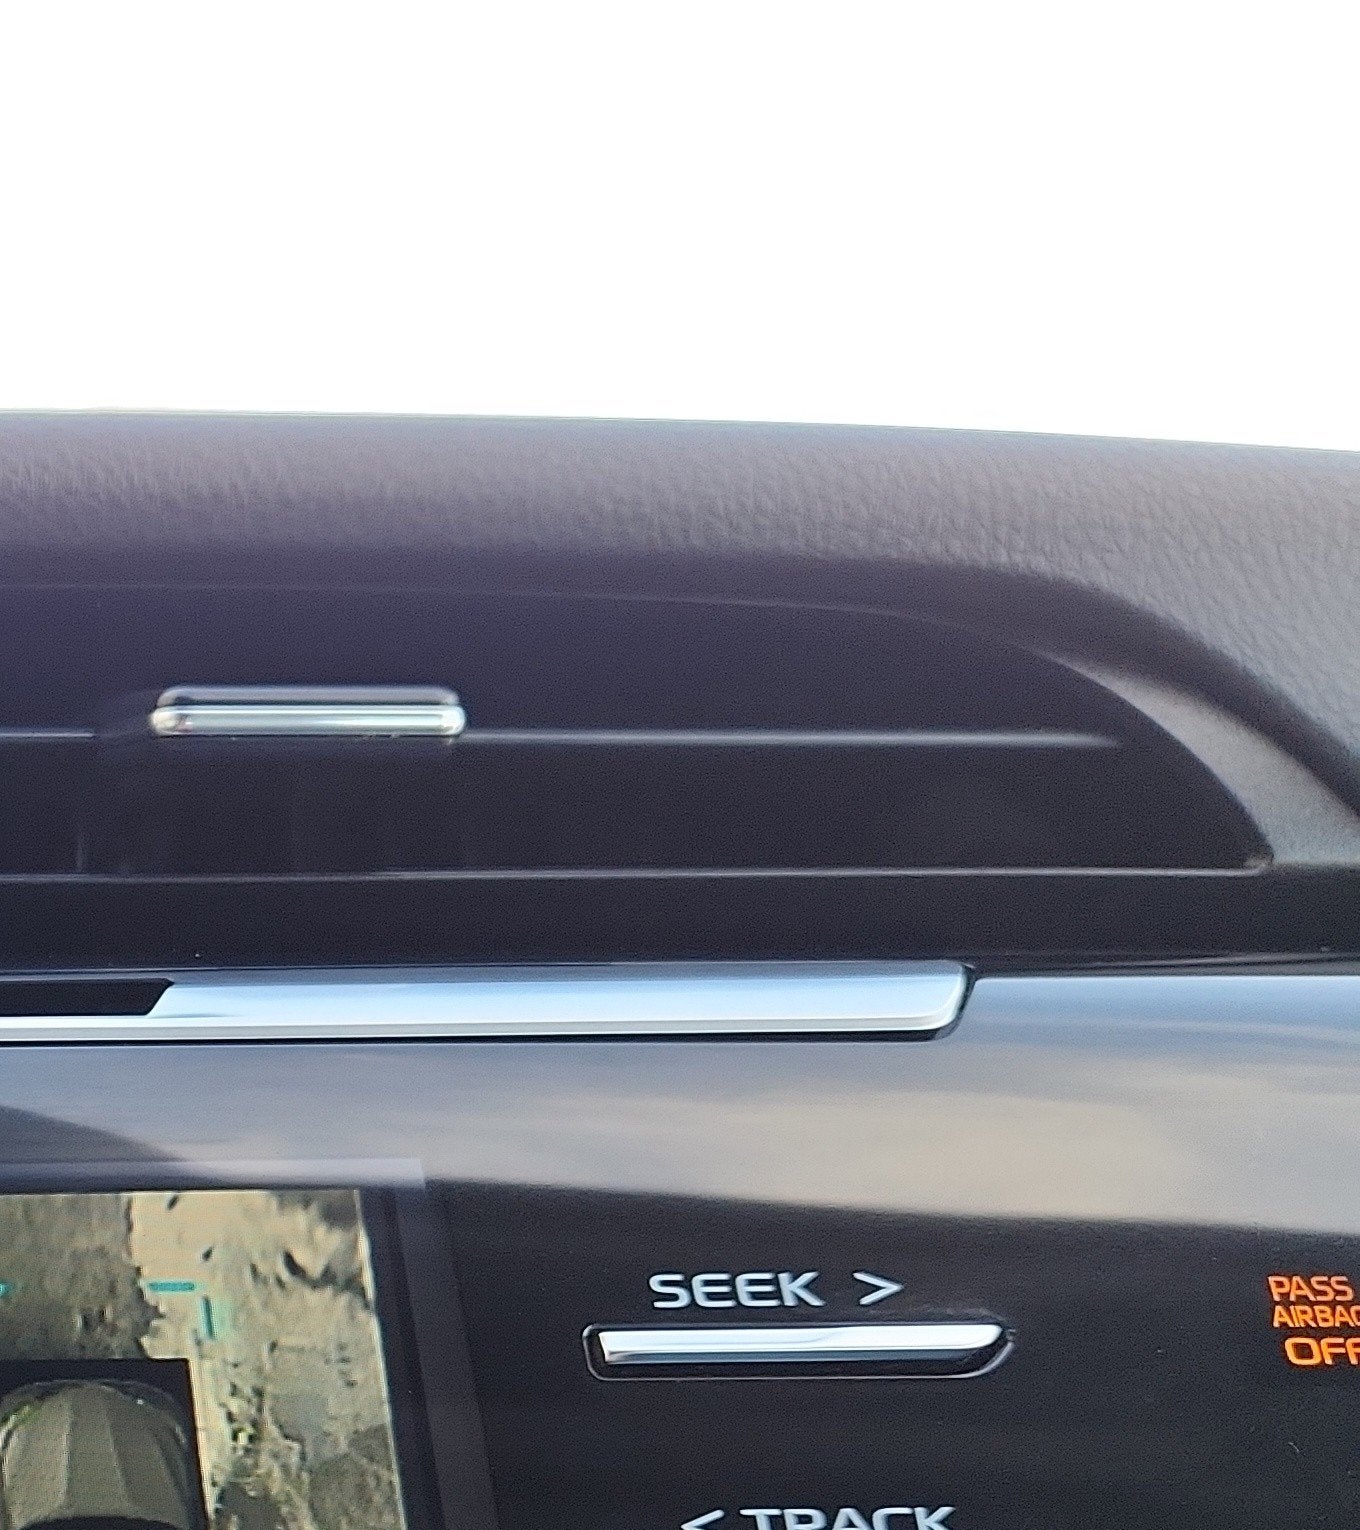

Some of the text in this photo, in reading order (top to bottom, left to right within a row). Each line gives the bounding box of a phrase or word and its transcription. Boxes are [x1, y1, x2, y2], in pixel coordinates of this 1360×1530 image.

[649, 1271, 825, 1309] SEEK
[1267, 1275, 1354, 1302] PASS
[1284, 1337, 1360, 1366] OFF
